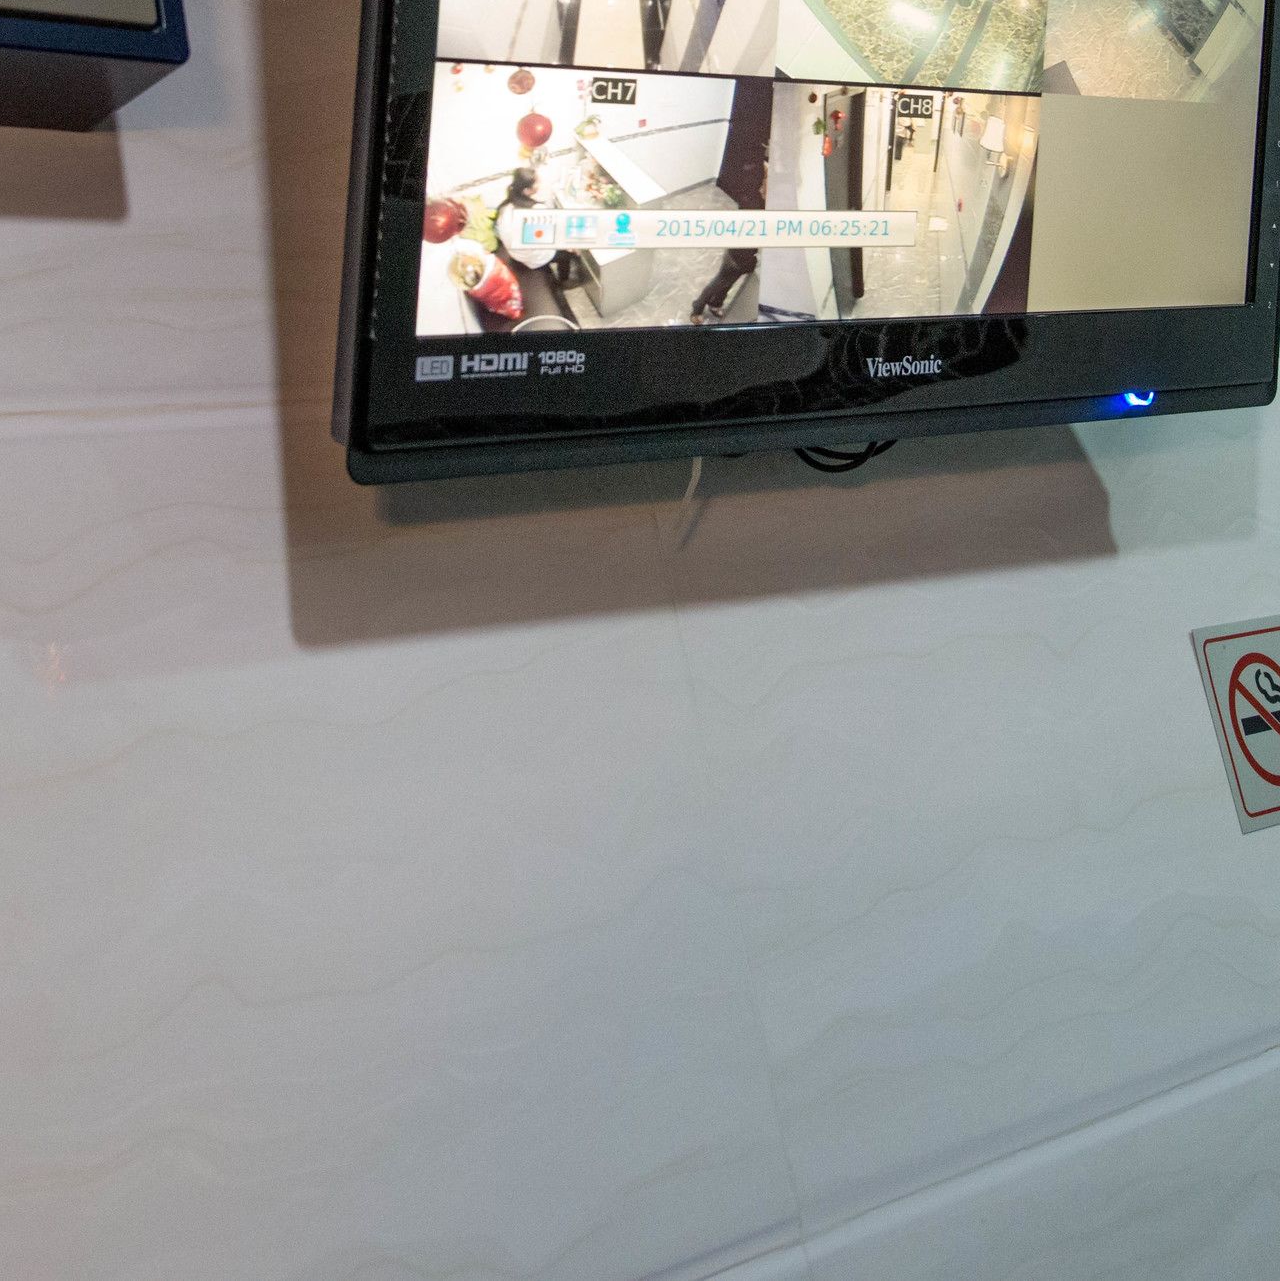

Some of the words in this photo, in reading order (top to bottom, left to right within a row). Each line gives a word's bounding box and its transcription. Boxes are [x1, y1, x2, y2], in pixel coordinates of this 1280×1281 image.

[592, 80, 636, 101] CH7
[898, 97, 933, 116] CH8
[656, 219, 769, 238] 2015/04/21
[776, 220, 803, 237] PM
[808, 219, 890, 237] 06:25:21
[460, 352, 529, 372] HDMI
[538, 350, 586, 365] 1080p
[866, 355, 942, 378] ViewSonic
[540, 366, 561, 375] Full
[565, 364, 585, 374] HD
